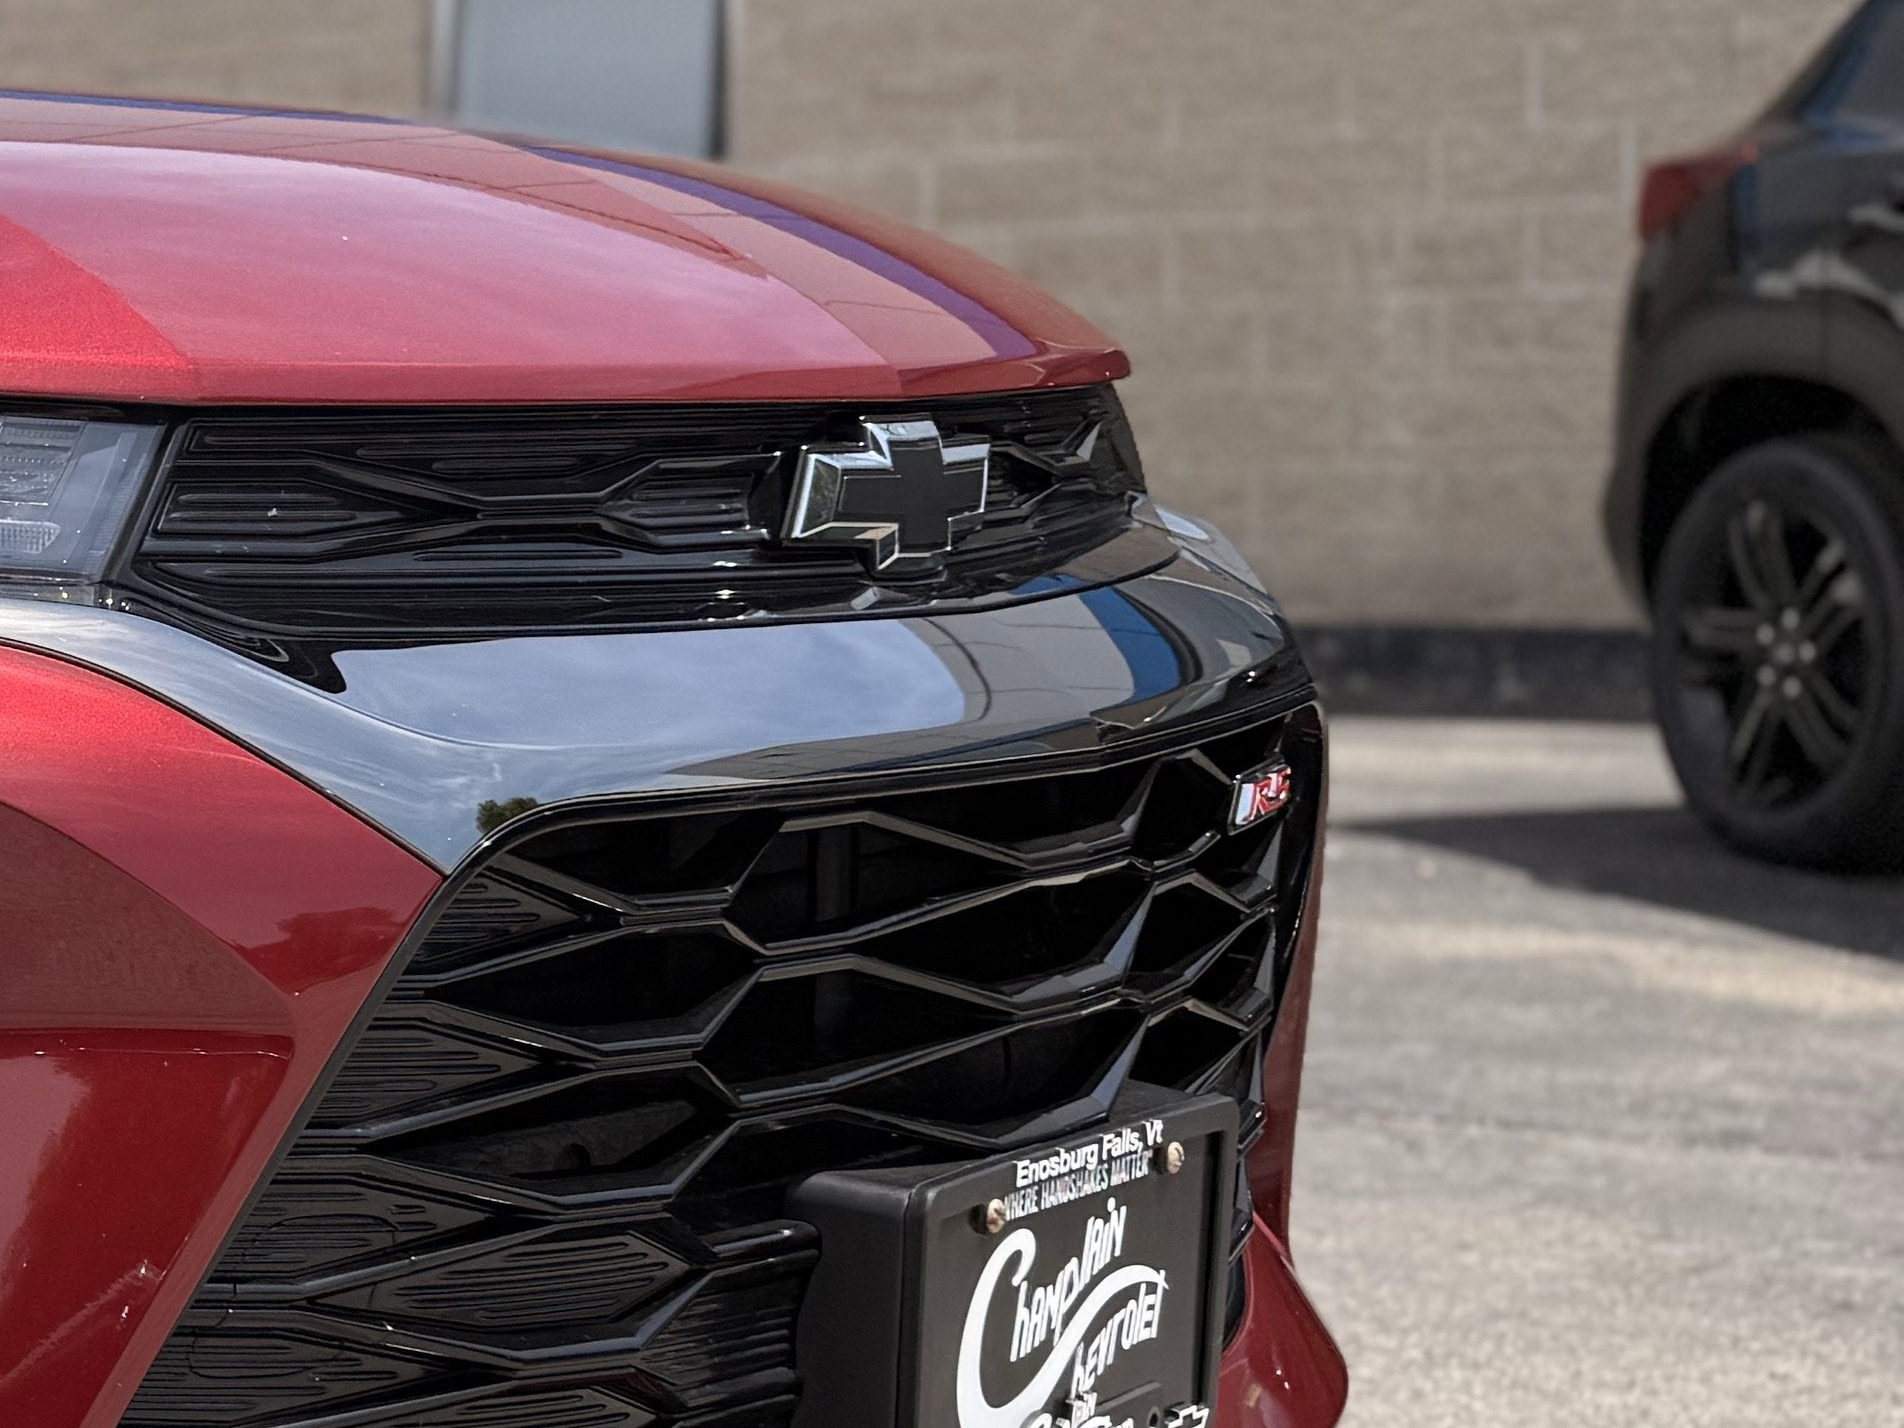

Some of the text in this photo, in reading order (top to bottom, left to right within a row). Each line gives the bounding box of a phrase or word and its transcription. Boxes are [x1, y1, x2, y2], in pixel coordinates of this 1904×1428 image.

[1015, 1142, 1100, 1189] Enosburg
[1142, 1119, 1164, 1147] Vt
[1040, 1163, 1109, 1211] HANDSHAKES
